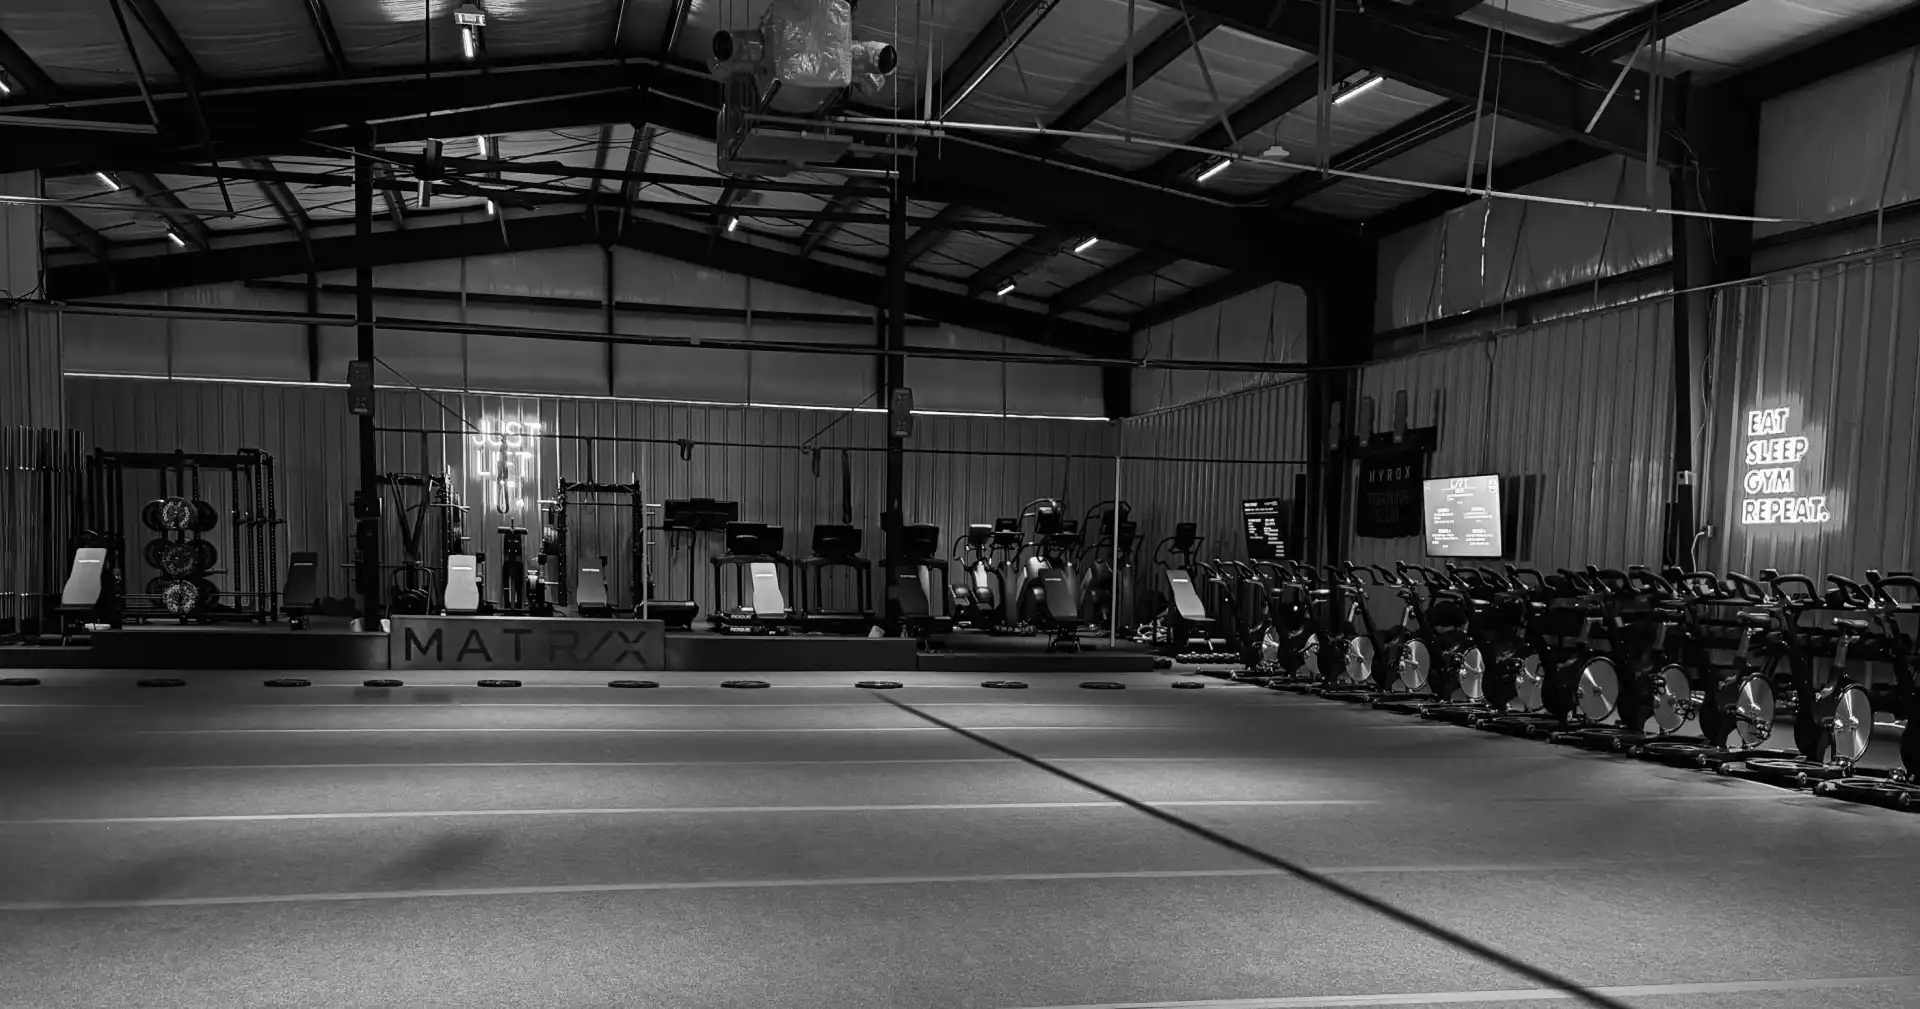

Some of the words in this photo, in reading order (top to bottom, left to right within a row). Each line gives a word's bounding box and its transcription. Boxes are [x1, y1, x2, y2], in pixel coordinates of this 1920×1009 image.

[472, 419, 541, 448] JUST
[1748, 407, 1790, 436] EAT
[1745, 436, 1809, 465] SLEEP
[1369, 465, 1413, 483] HYROX
[1744, 467, 1795, 494] GYM
[1742, 496, 1830, 524] REPEAT.
